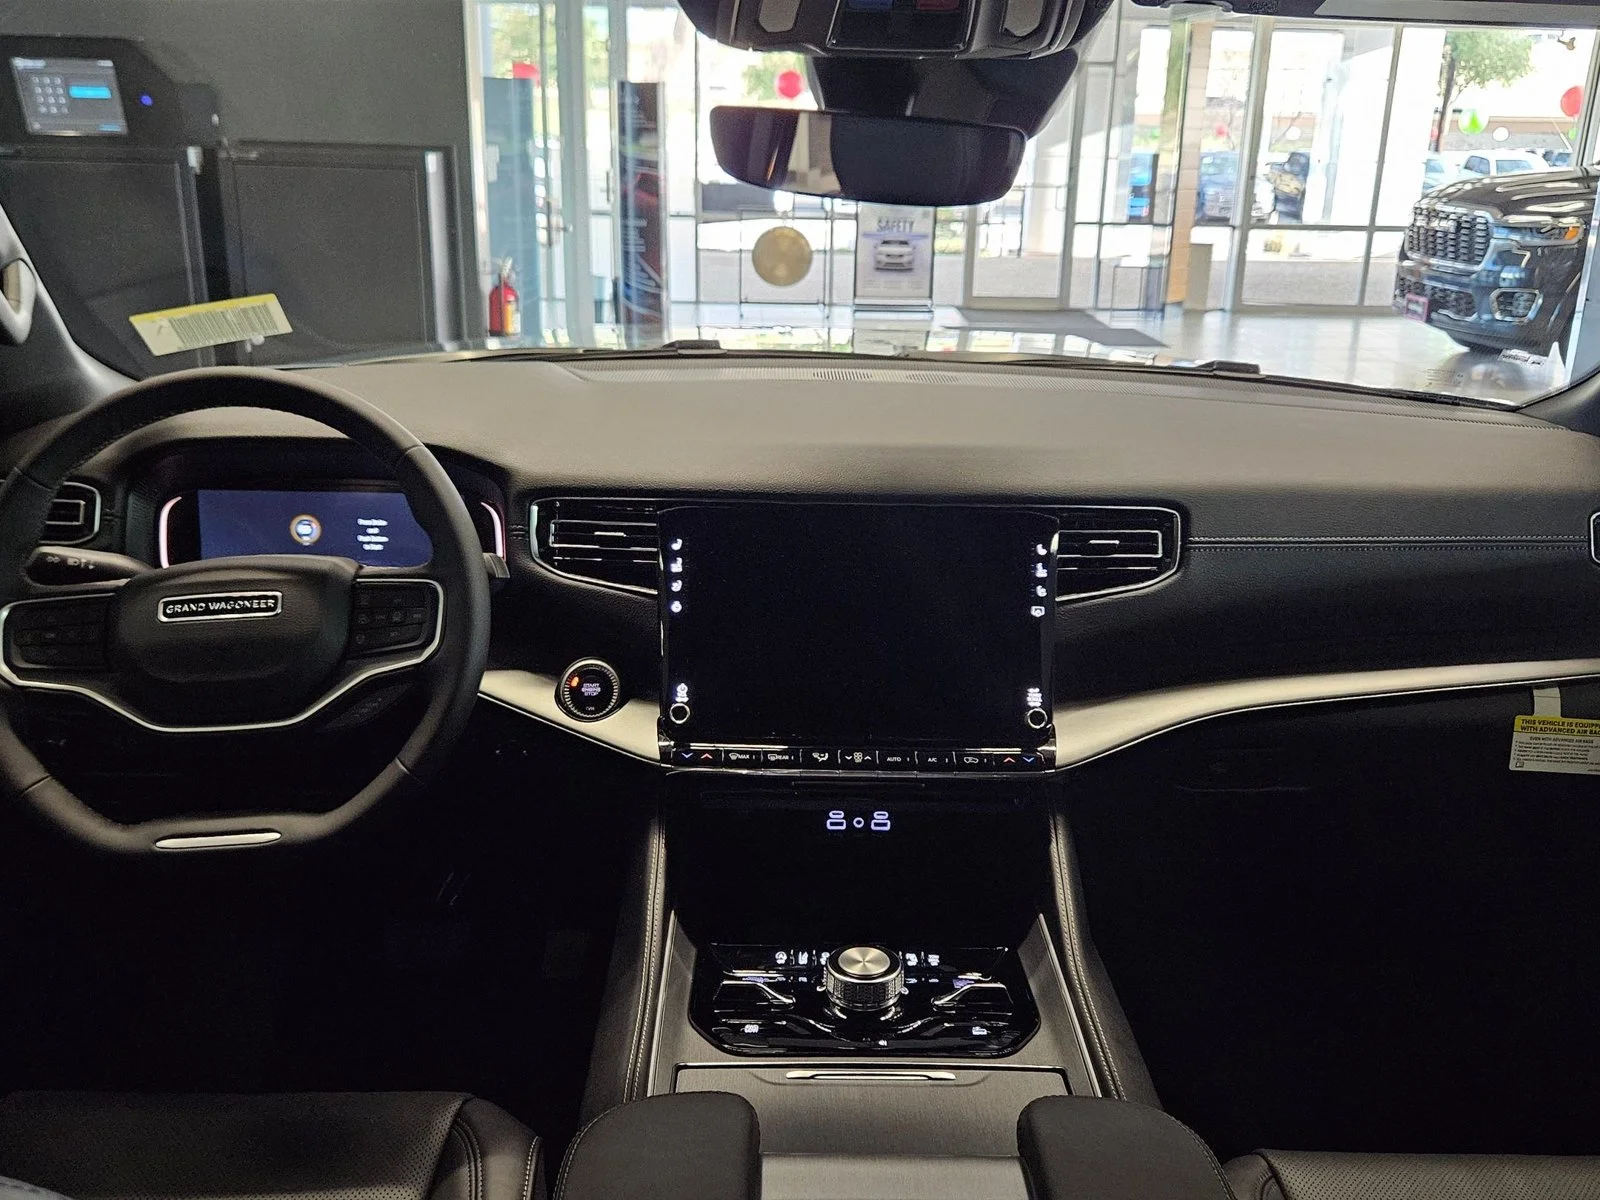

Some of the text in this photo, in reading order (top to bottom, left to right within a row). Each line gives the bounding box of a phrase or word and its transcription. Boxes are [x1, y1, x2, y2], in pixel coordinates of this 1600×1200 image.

[876, 219, 915, 233] SAFETY
[165, 599, 276, 614] GRAND WAGONEER
[1539, 726, 1575, 734] ADVANCED
